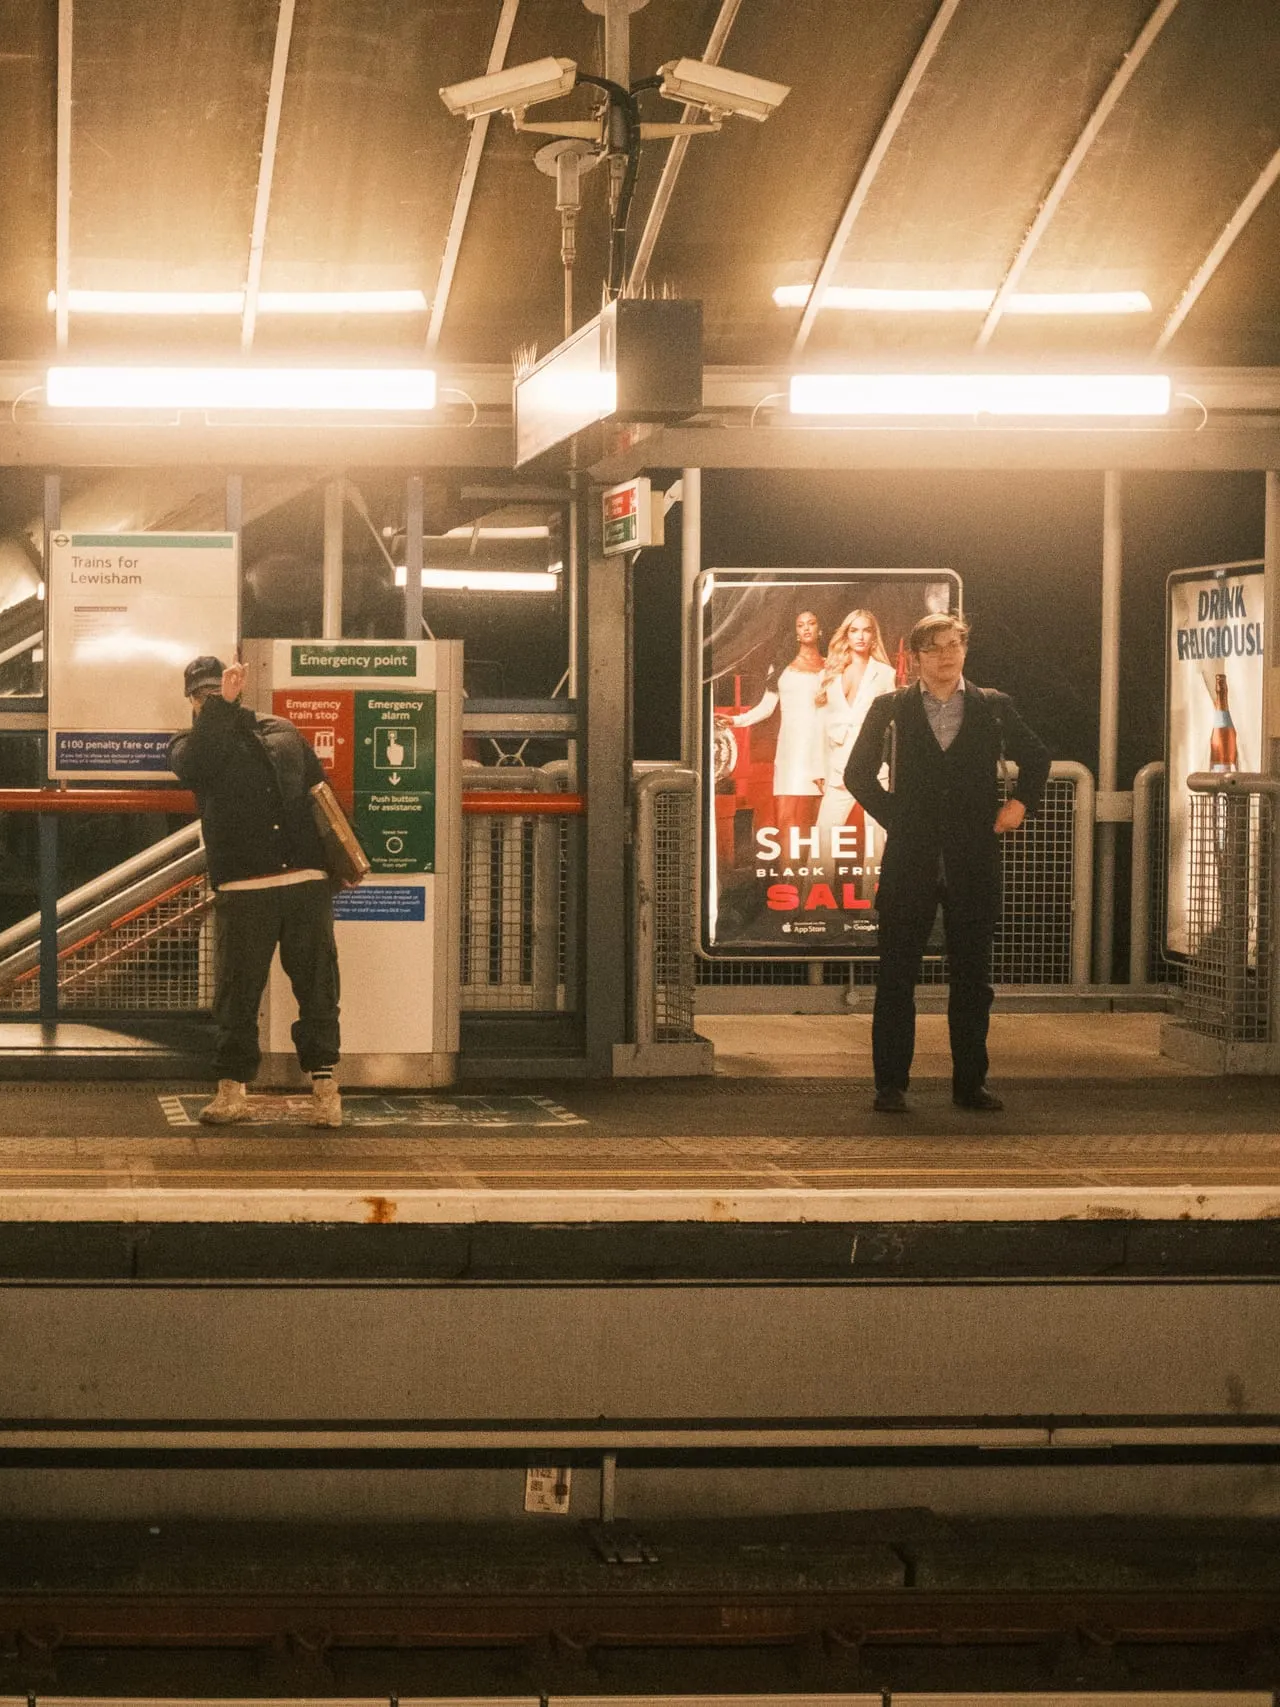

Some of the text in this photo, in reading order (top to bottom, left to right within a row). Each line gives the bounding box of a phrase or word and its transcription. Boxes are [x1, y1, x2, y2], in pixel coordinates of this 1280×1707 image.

[72, 556, 139, 568] Trains for
[70, 572, 142, 584] Lewisham
[1198, 585, 1246, 621] DRINK
[300, 655, 408, 667] Emergency point
[285, 699, 341, 711] Emergency
[368, 699, 423, 711] Emergency
[289, 711, 339, 721] train stop
[381, 711, 410, 720] alarm
[60, 740, 83, 749] £100
[86, 740, 120, 751] penalty
[123, 740, 142, 749] fare
[371, 795, 419, 803] Push button
[756, 867, 824, 878] BLACK
[767, 883, 879, 911] SAL
